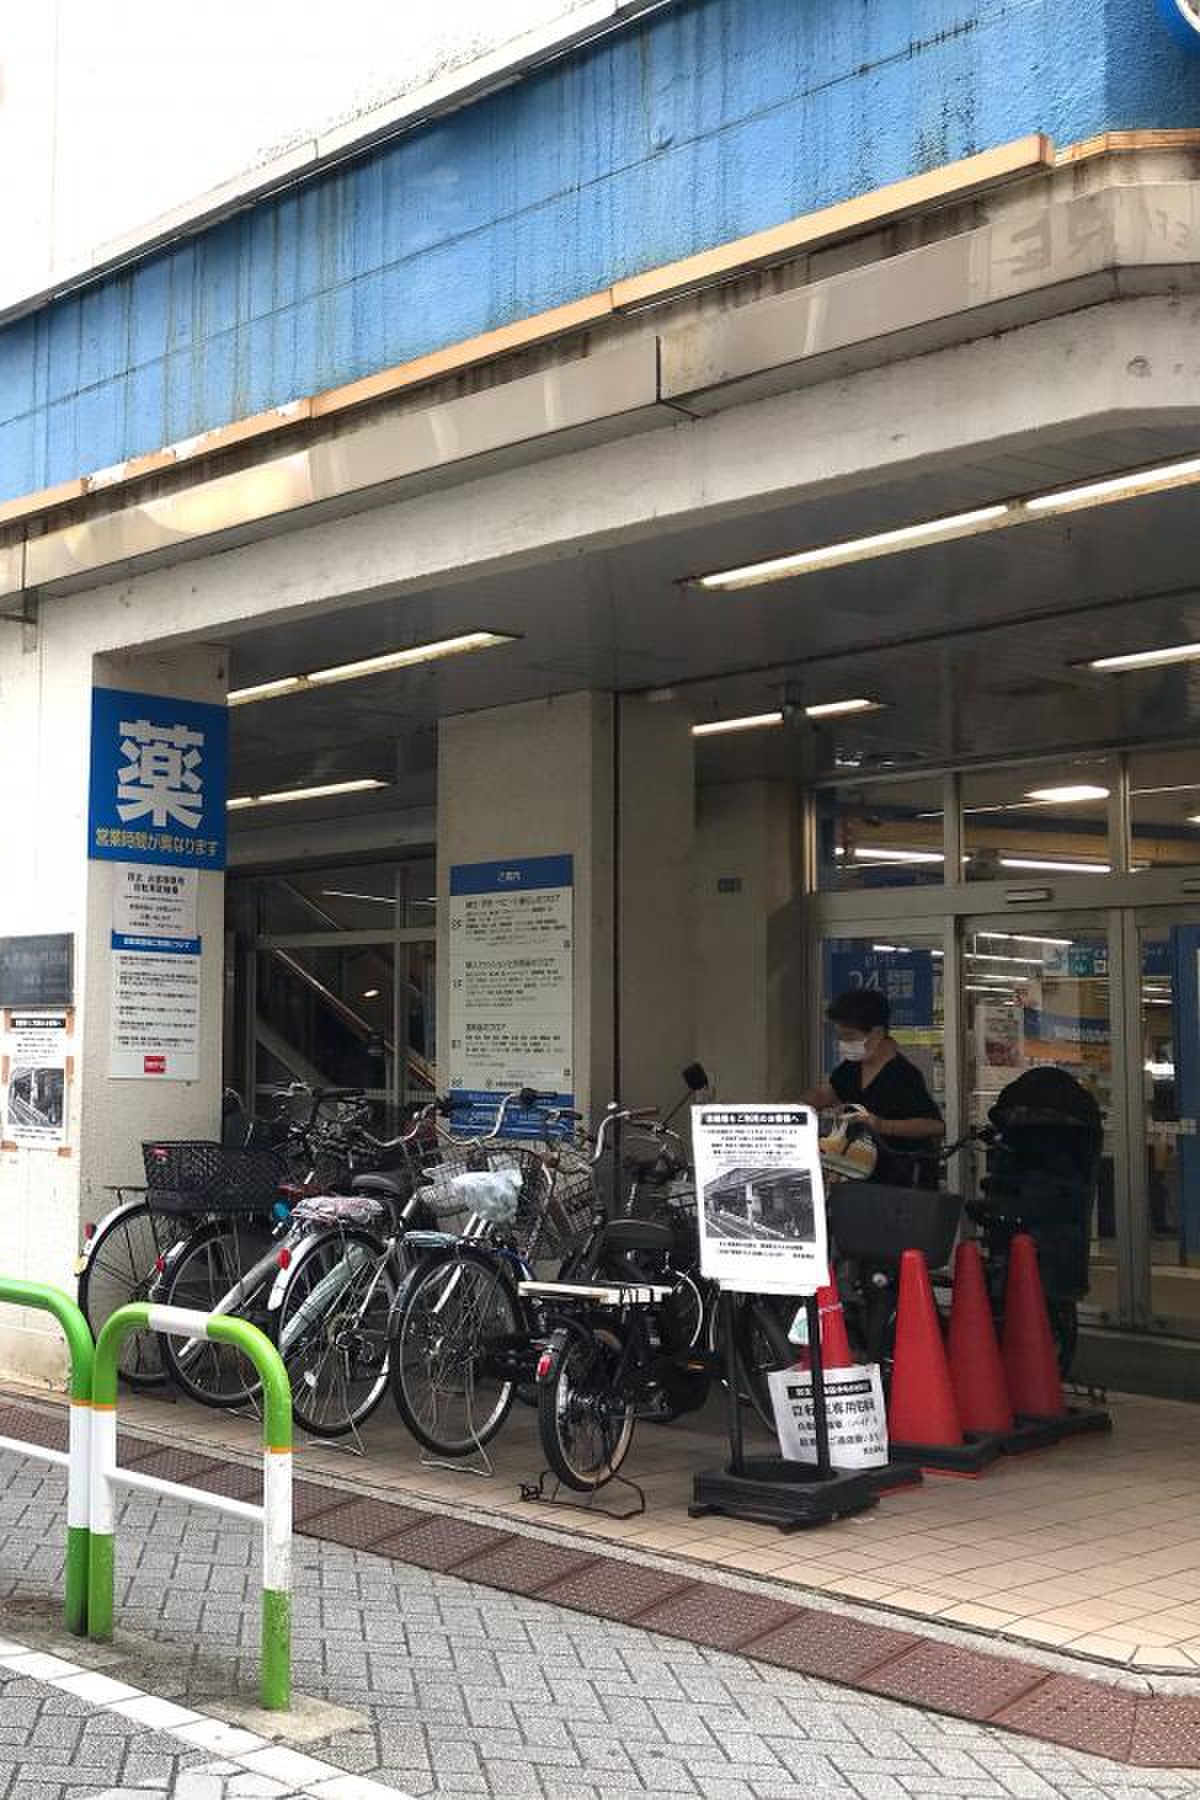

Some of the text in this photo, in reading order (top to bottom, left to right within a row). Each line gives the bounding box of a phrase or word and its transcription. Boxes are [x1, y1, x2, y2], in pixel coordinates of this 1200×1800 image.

[117, 719, 204, 829] 薬
[95, 827, 219, 857] 営業時間が異なります
